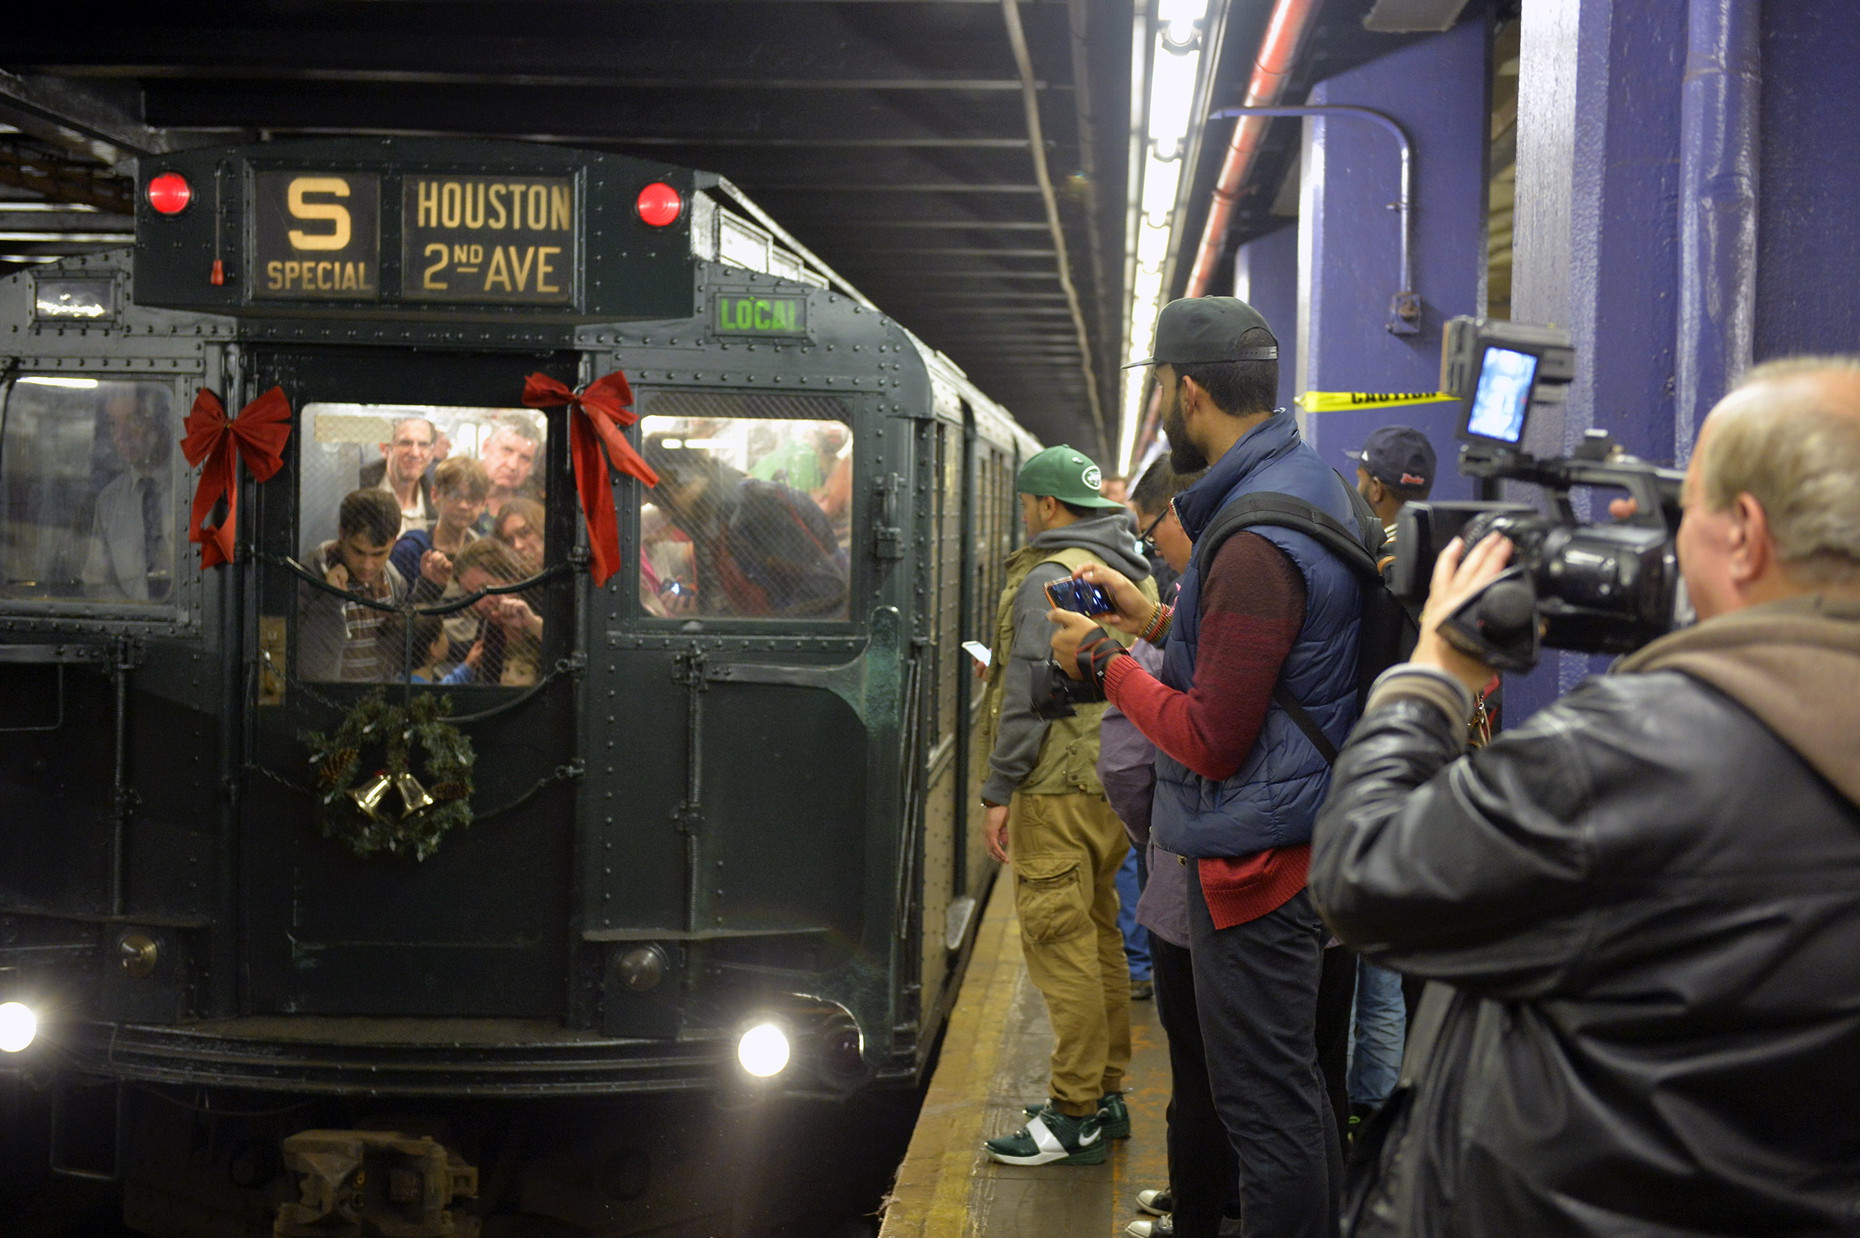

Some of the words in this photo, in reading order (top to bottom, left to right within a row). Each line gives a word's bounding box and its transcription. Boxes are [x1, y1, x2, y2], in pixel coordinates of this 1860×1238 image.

[287, 177, 351, 250] S
[417, 181, 571, 231] HOUSTON
[267, 261, 373, 291] SPECIAL
[423, 243, 483, 290] 2ND
[484, 245, 561, 293] AVE
[721, 299, 804, 331] LOCAL
